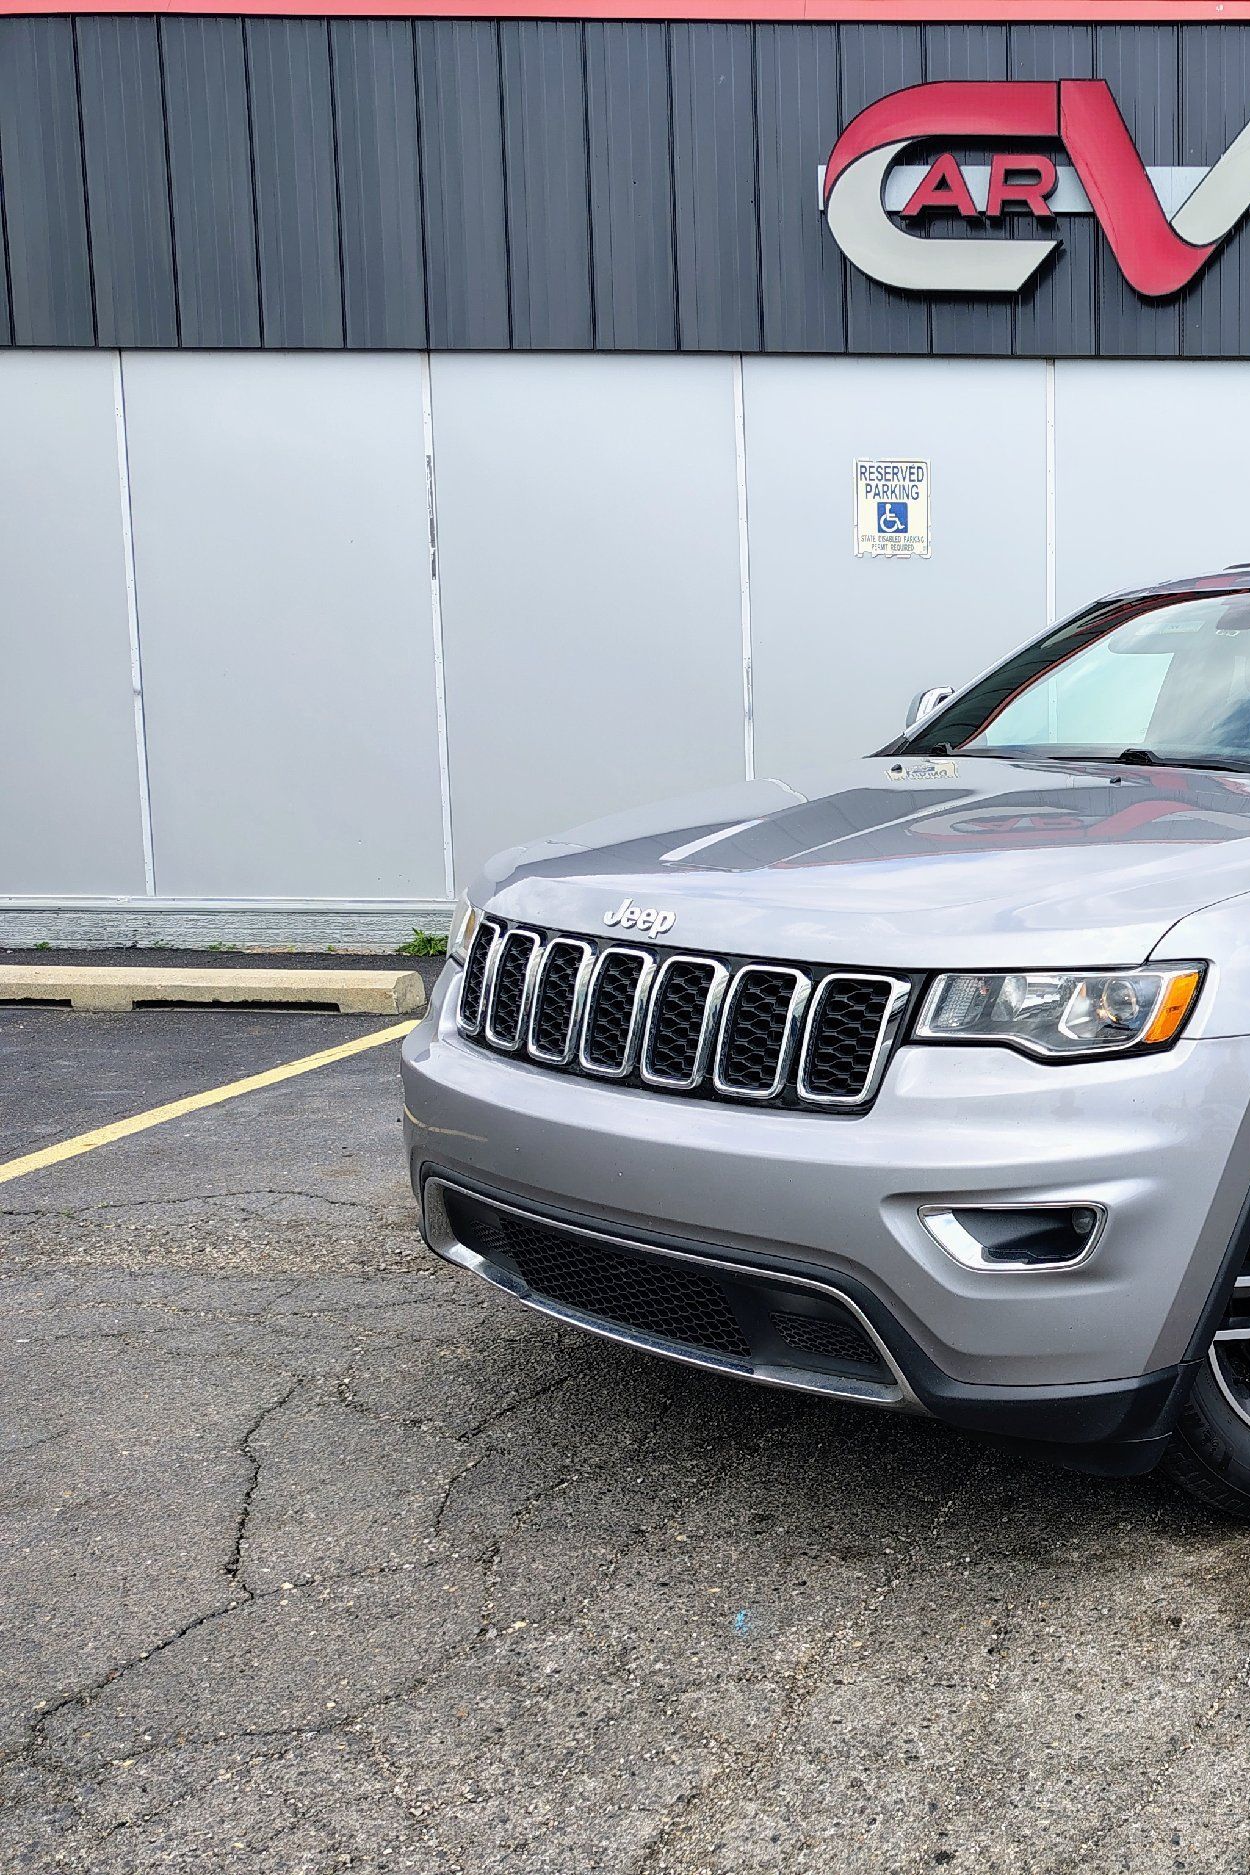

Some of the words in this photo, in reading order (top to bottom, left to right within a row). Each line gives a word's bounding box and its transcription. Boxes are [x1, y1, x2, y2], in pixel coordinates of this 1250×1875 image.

[860, 465, 924, 482] RESERVED
[865, 483, 919, 500] PARKING
[861, 535, 875, 543] STATE
[603, 898, 677, 939] Jeep
